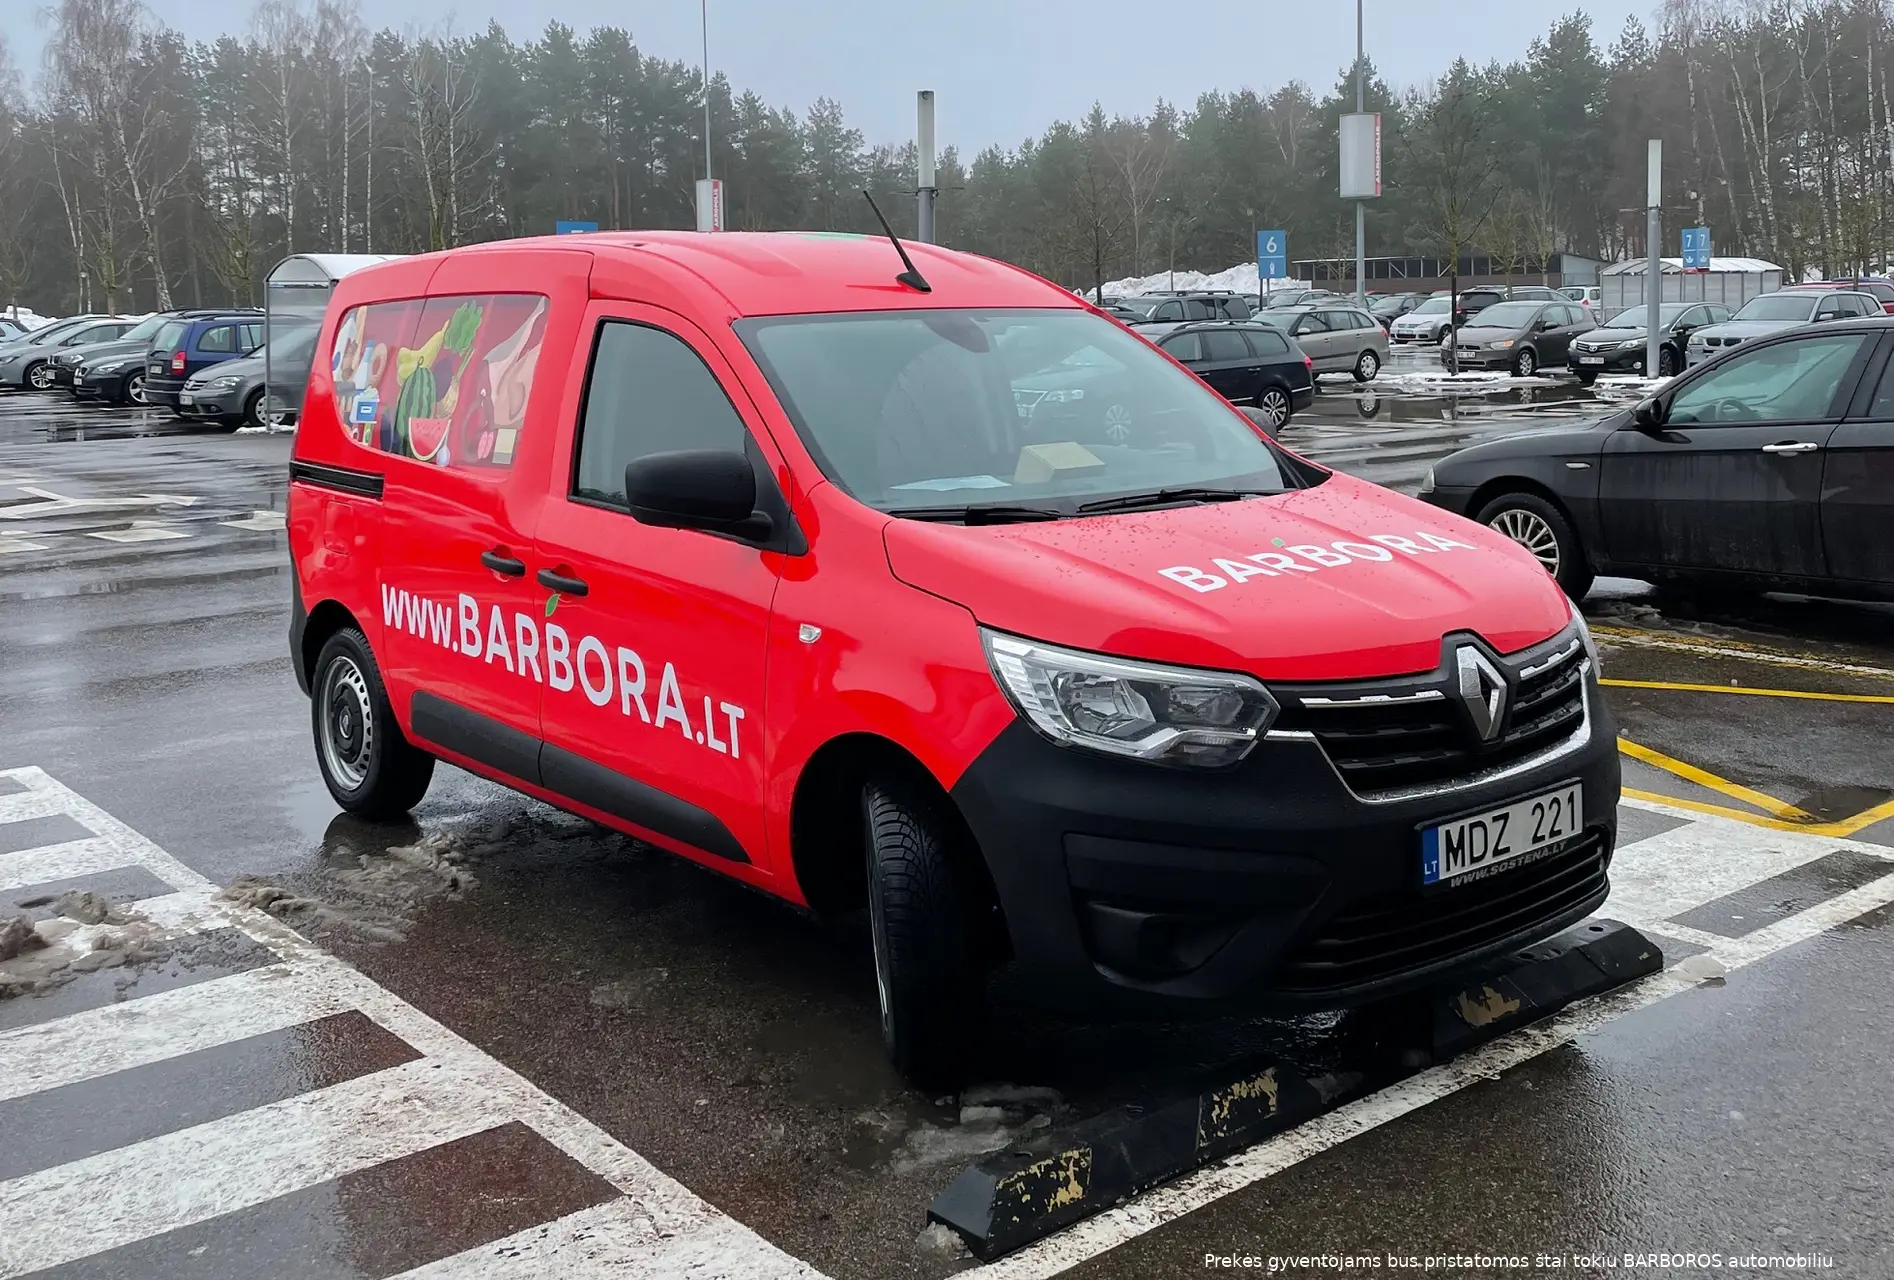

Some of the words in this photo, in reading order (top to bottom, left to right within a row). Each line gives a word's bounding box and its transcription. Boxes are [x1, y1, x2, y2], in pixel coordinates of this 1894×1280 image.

[1266, 236, 1277, 254] 6
[1685, 234, 1692, 248] 7
[1700, 233, 1706, 247] 7
[1157, 531, 1478, 593] BARBORA
[1424, 860, 1438, 875] LT
[1445, 812, 1511, 872] MDZ
[1531, 790, 1576, 845] 221
